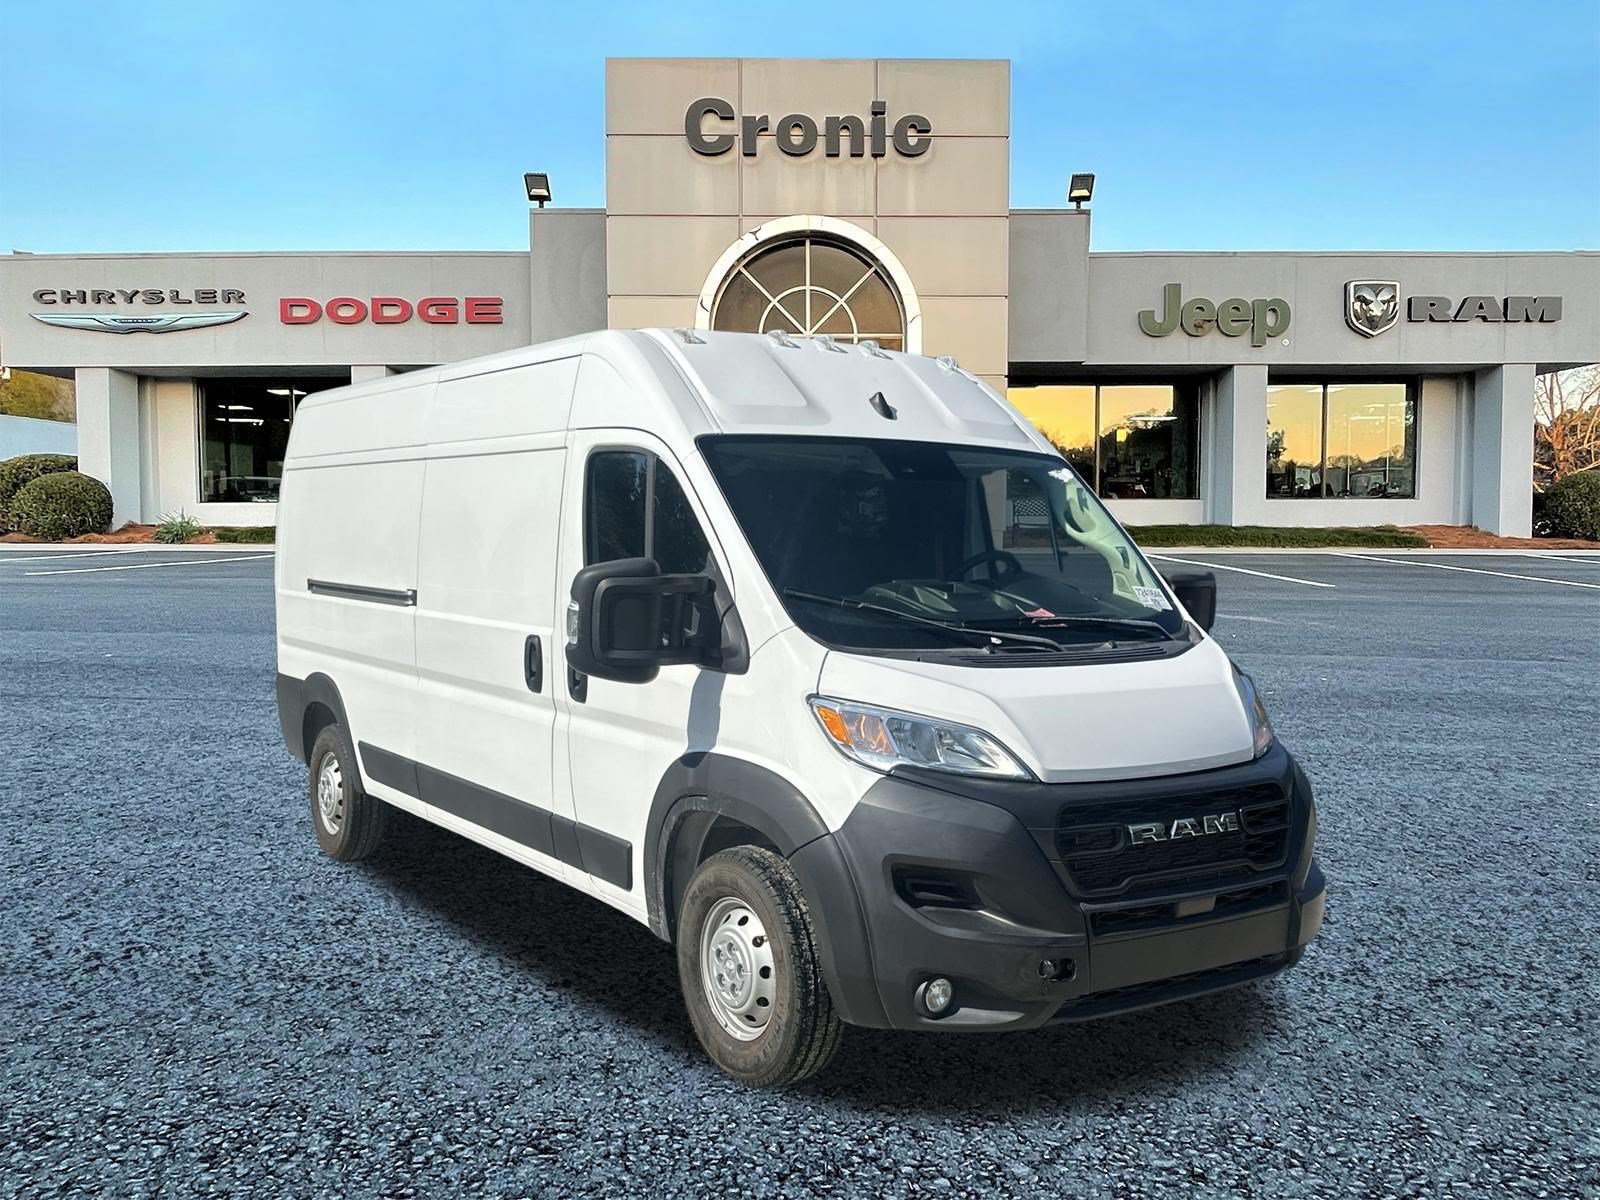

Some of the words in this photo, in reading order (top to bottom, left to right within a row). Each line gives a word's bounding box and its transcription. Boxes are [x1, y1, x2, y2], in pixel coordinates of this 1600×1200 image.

[685, 97, 932, 158] Cronic
[32, 288, 247, 305] CHRYSLER
[279, 297, 504, 325] DODGE
[1407, 296, 1563, 323] RAM
[1138, 283, 1291, 348] Jeep
[1128, 812, 1239, 845] RAM
